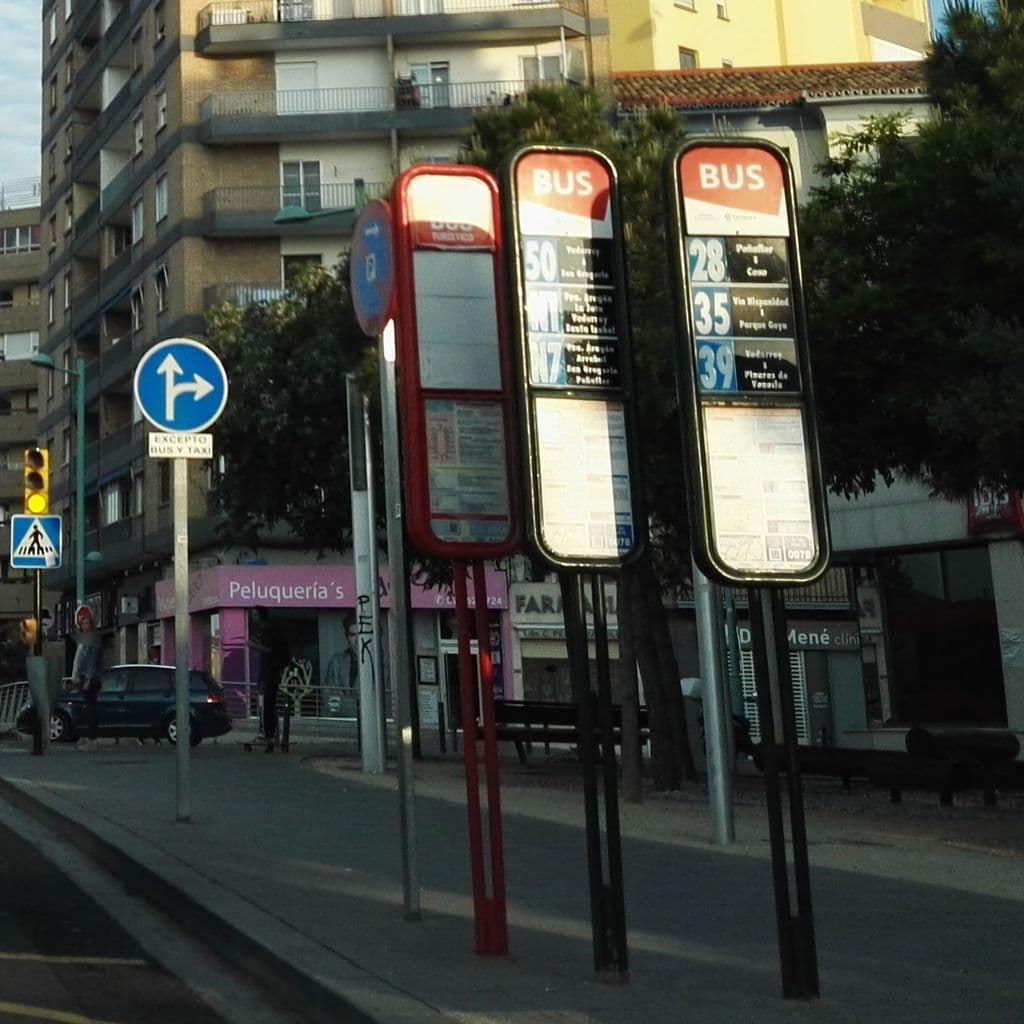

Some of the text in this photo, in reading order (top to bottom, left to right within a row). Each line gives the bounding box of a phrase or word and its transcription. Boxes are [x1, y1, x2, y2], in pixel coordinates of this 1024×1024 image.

[532, 168, 593, 195] BUS
[699, 163, 765, 190] BUS
[525, 239, 557, 282] 50
[689, 238, 726, 282] 28
[695, 291, 731, 336] 35
[698, 345, 734, 389] 39
[150, 445, 212, 456] BUS Y TAXI
[154, 434, 208, 445] EXCEPTO
